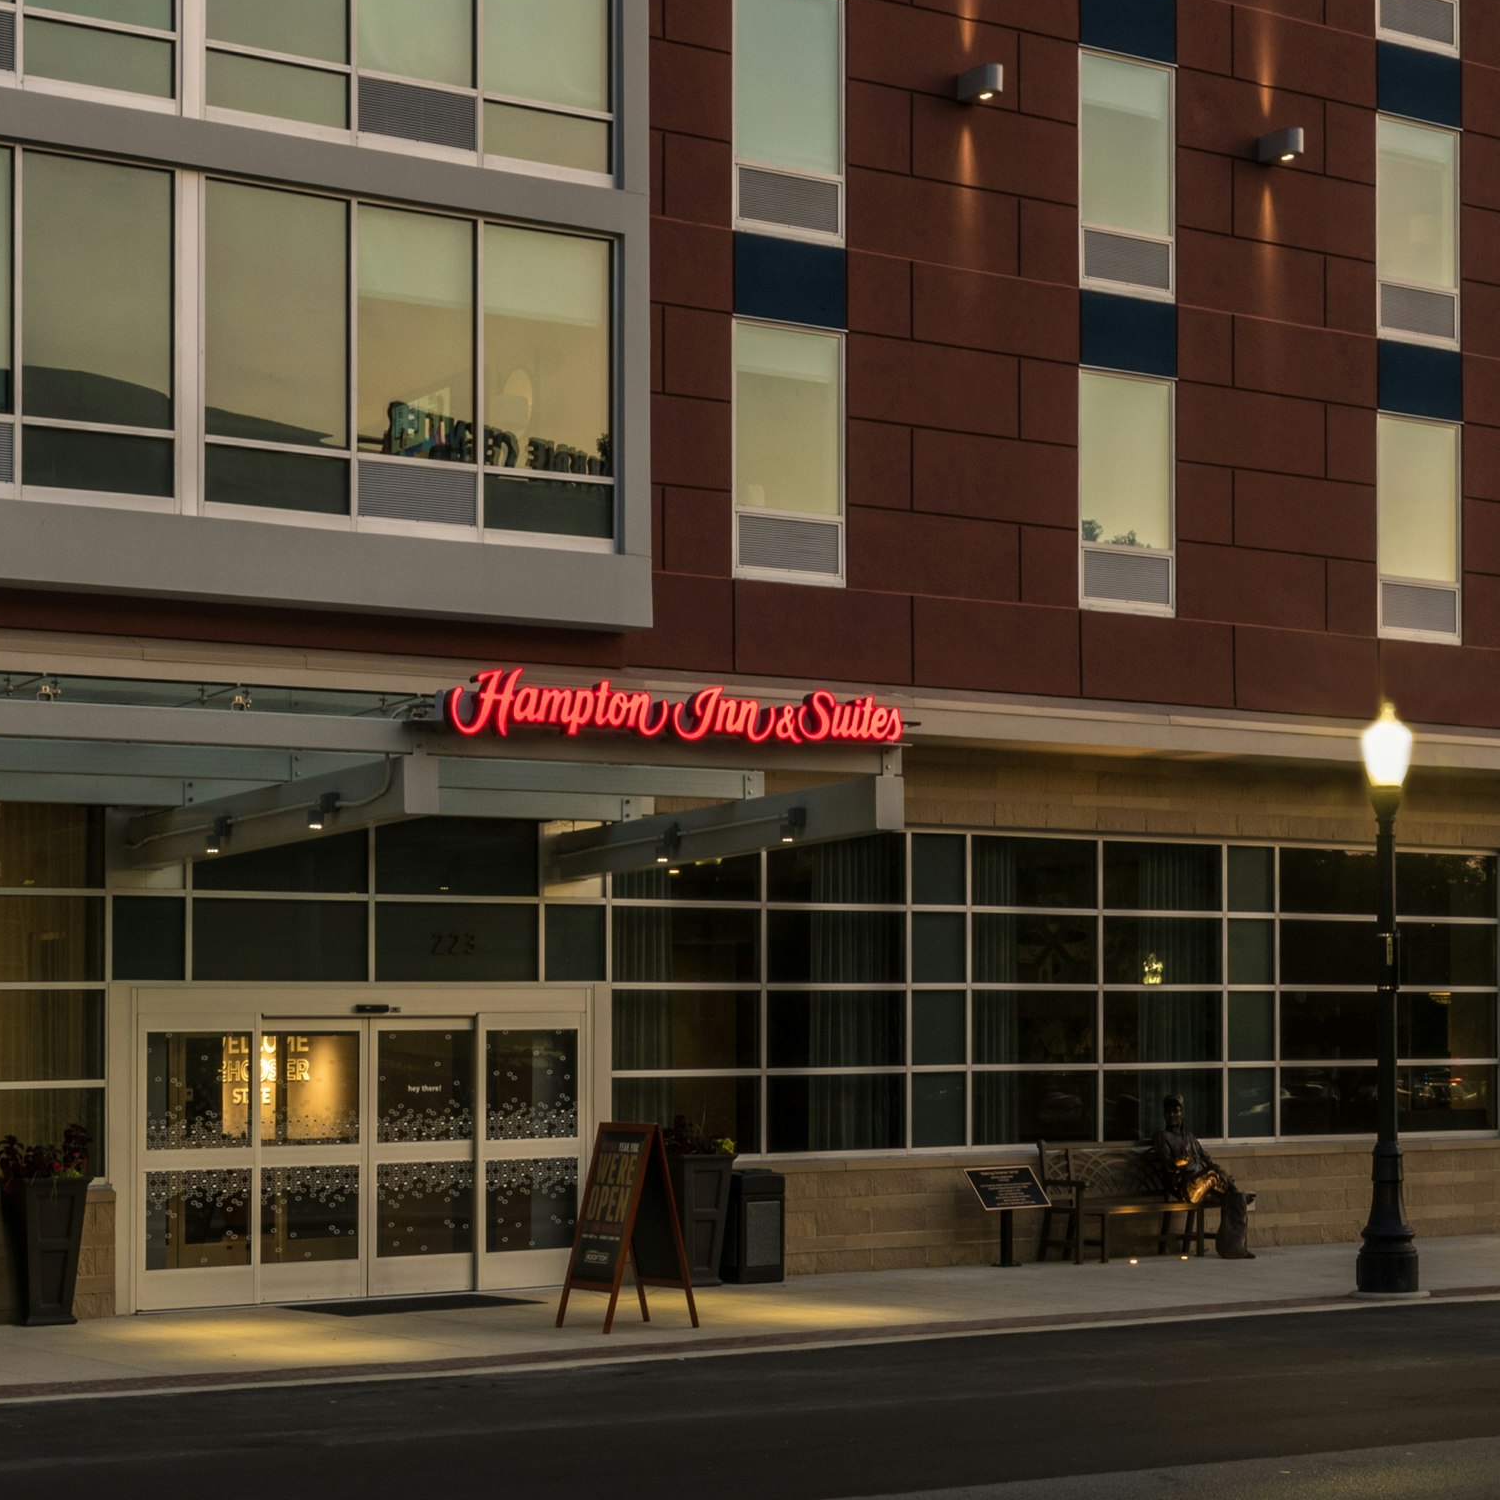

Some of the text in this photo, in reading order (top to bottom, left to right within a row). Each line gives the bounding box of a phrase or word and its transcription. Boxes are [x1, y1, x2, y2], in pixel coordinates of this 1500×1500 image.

[450, 667, 902, 743] Hampton Inn & Suites
[432, 933, 476, 955] 223
[407, 1084, 442, 1094] hey there!
[587, 1186, 632, 1223] OPEN
